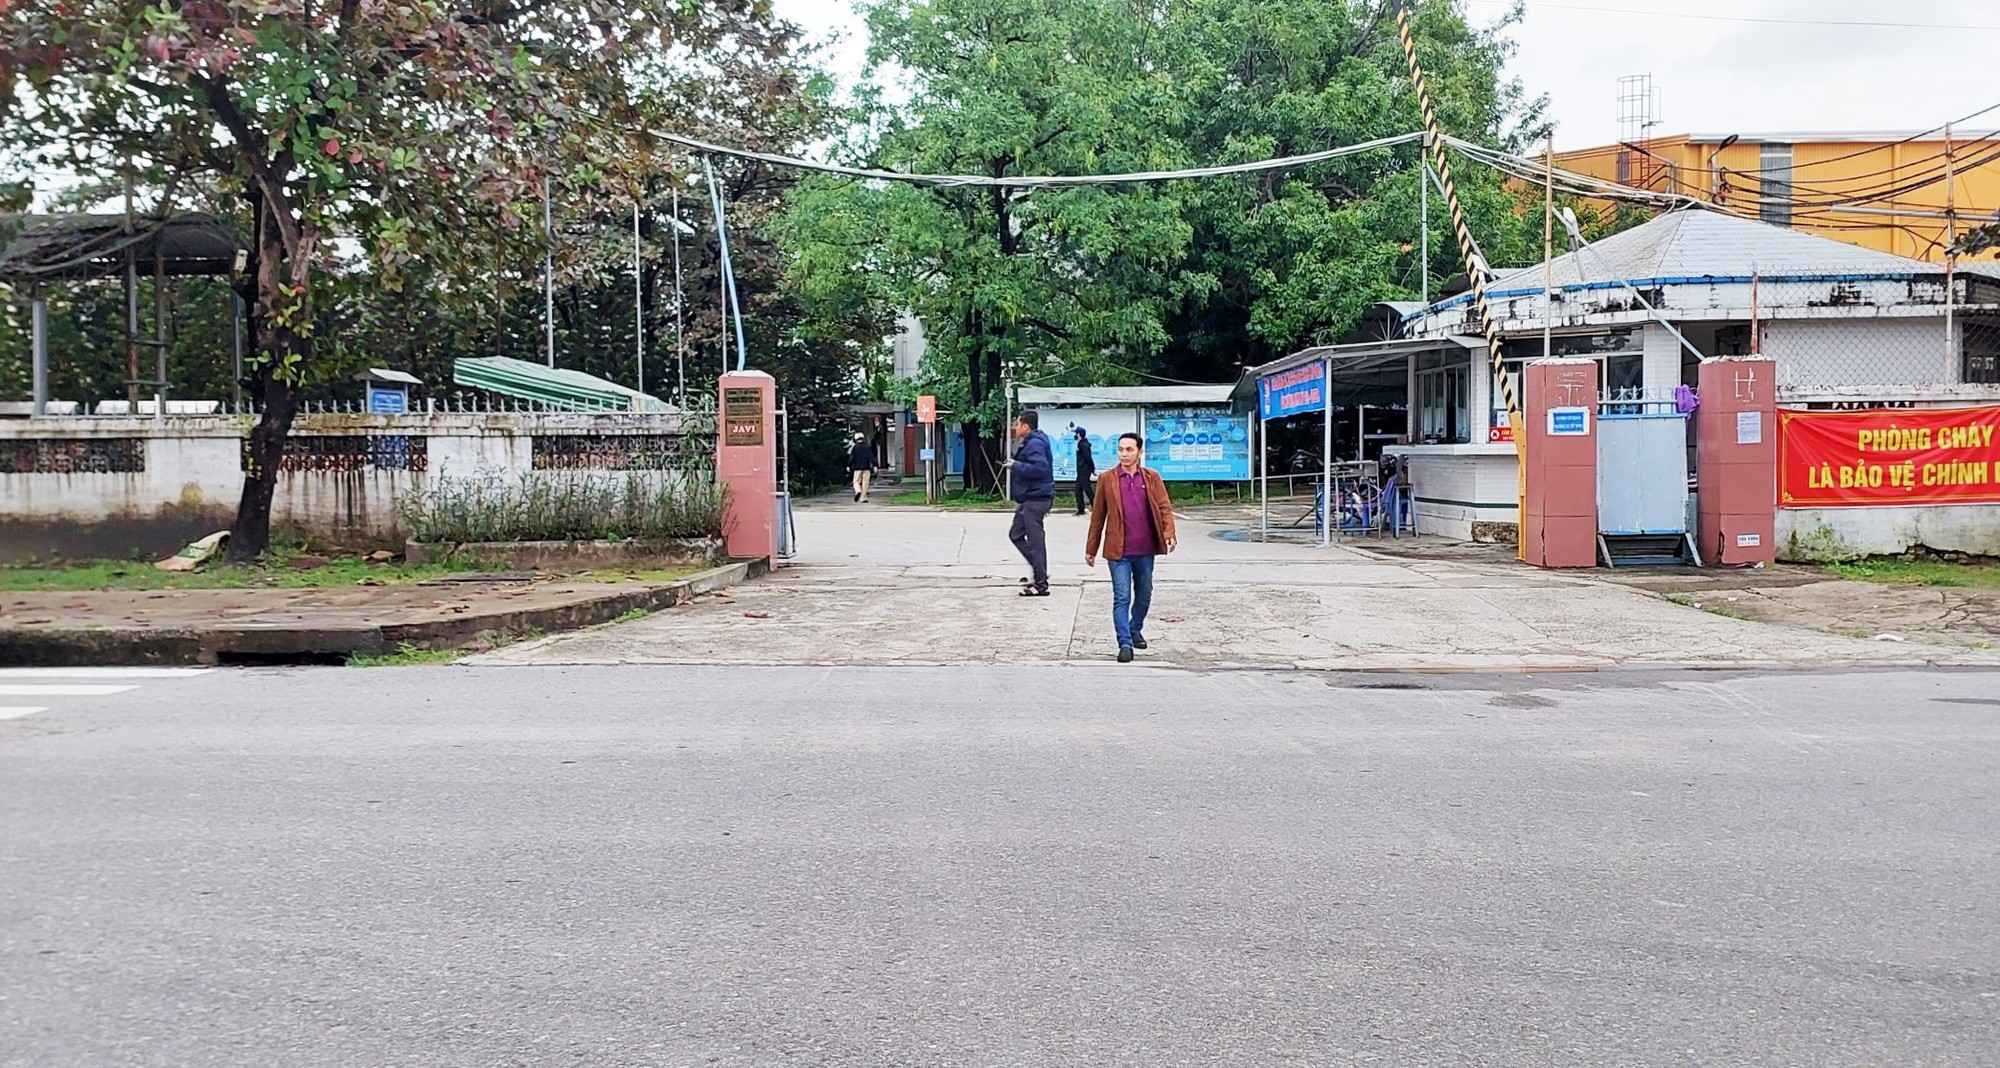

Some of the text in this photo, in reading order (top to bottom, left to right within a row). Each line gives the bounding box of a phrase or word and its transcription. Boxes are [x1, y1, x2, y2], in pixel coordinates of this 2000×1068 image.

[1858, 421, 1993, 451] PHÒNG CHÁY
[1808, 461, 1835, 488] LÀ
[1839, 459, 1882, 488] BẢO
[1889, 460, 1915, 490] VỆ
[1922, 459, 1988, 486] CHÍNH
